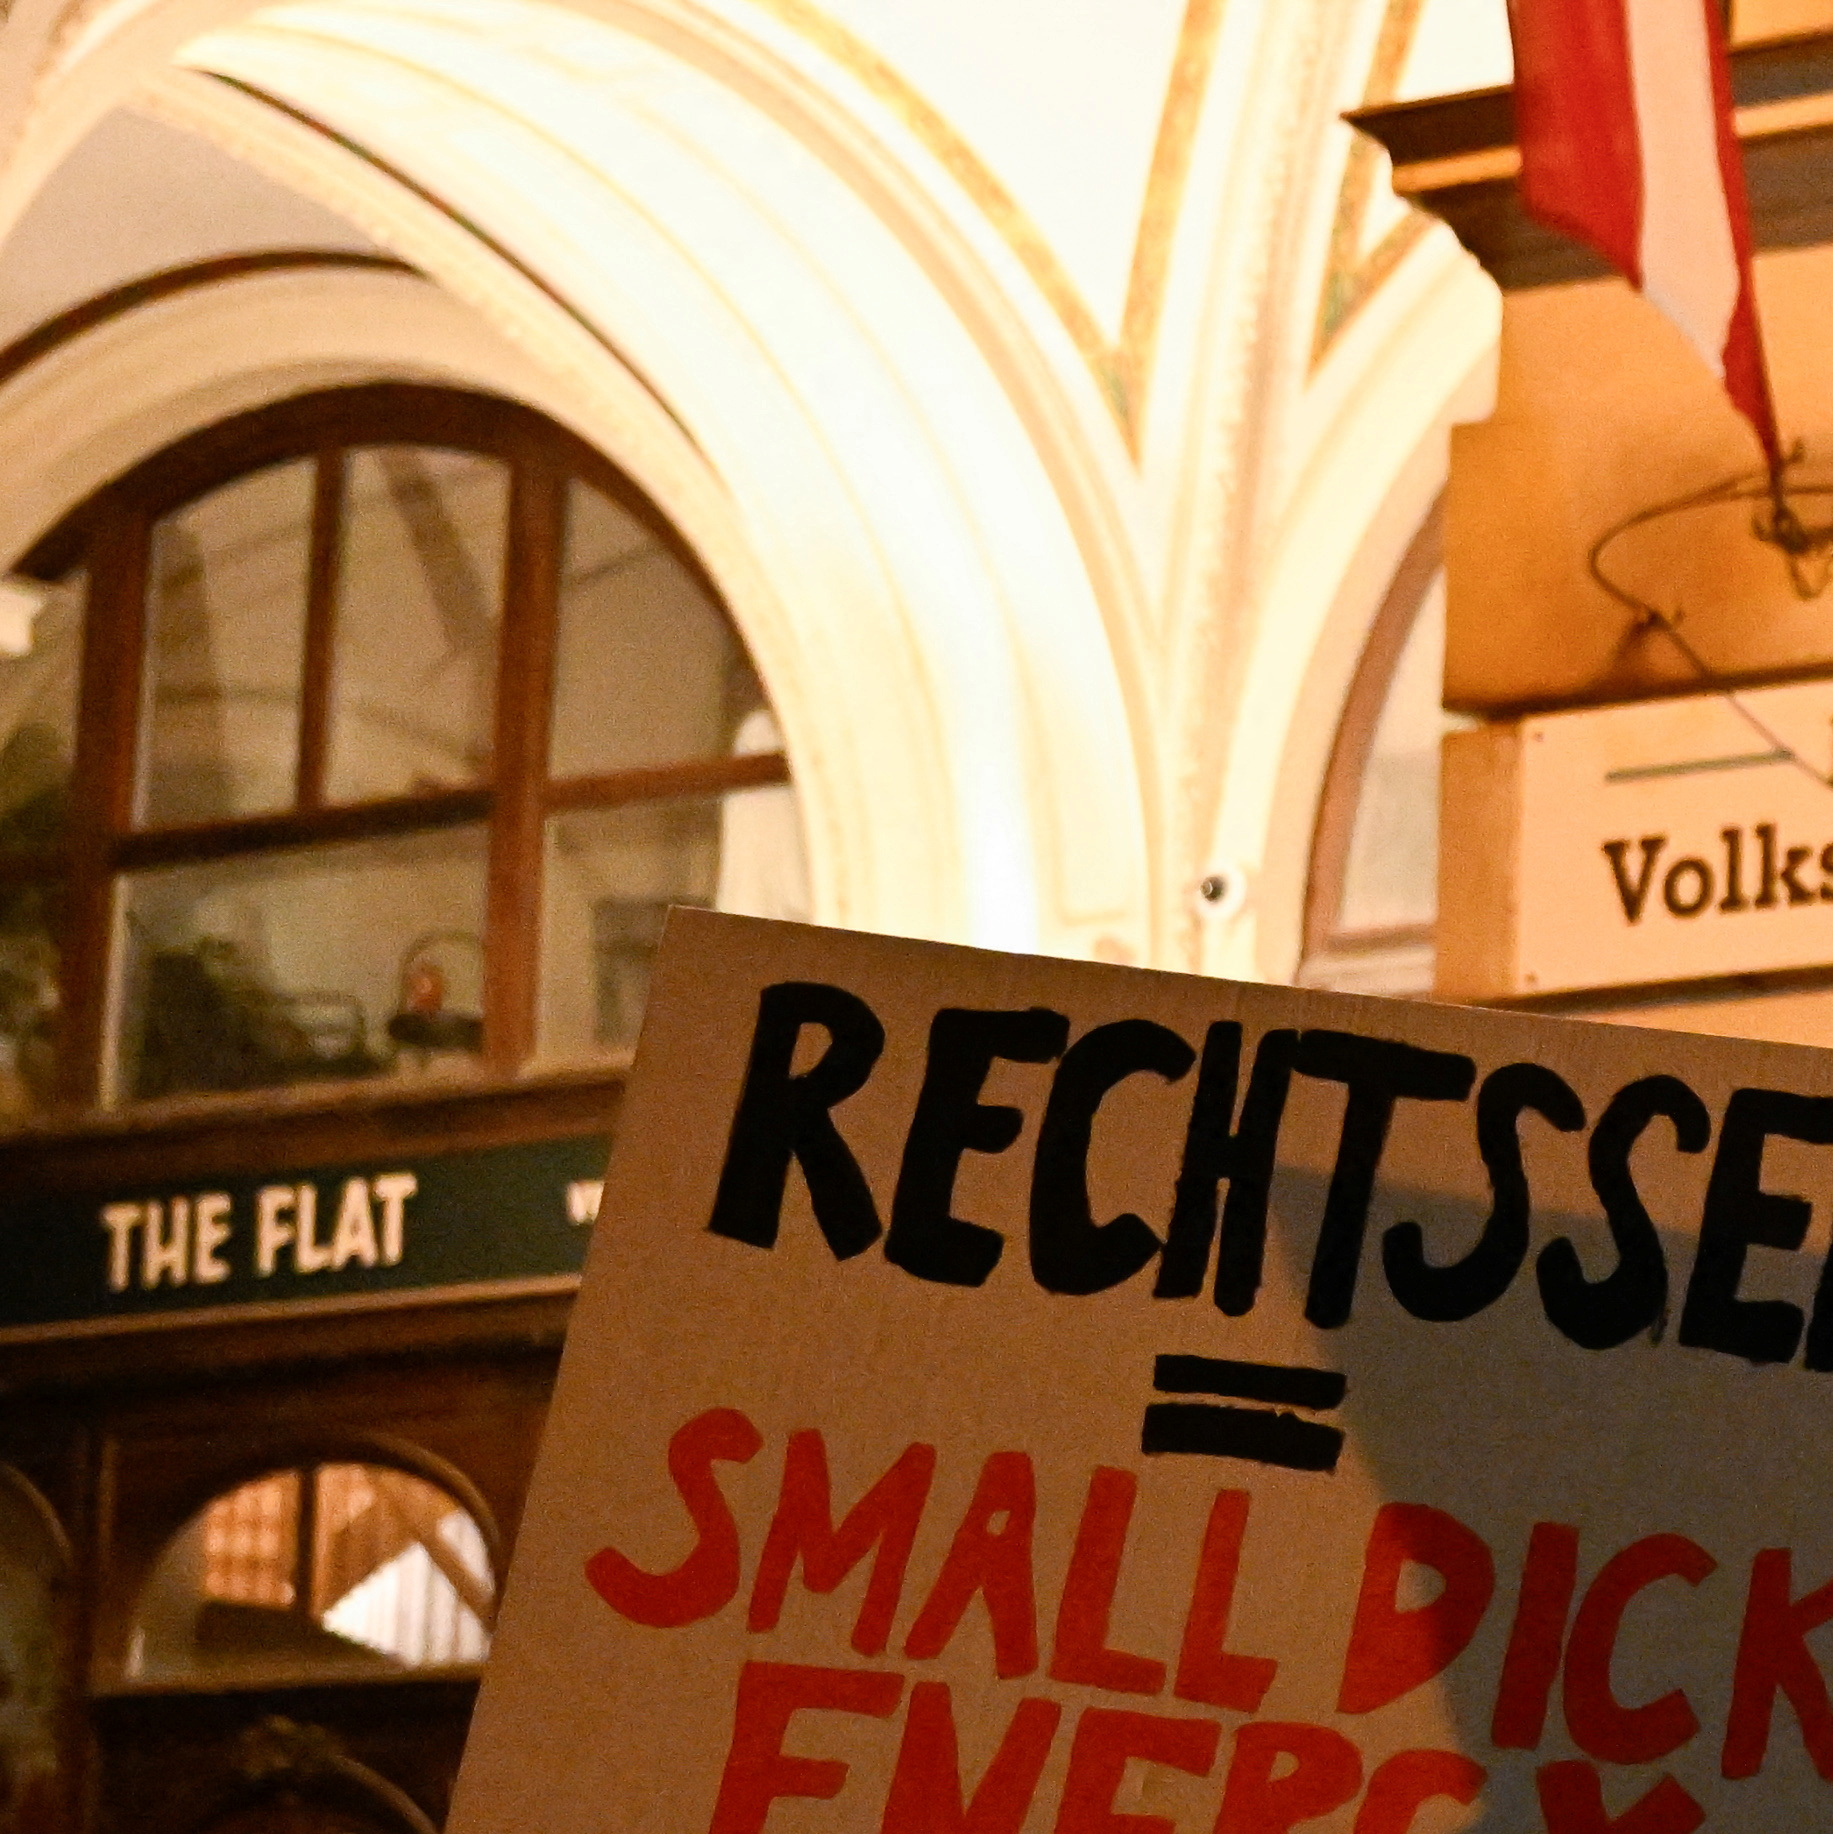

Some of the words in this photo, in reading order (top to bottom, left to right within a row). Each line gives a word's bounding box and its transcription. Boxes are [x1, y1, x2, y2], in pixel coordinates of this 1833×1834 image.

[101, 1192, 235, 1293] THE
[256, 1173, 418, 1276] FLAT
[584, 1406, 1288, 1714] SMALL
